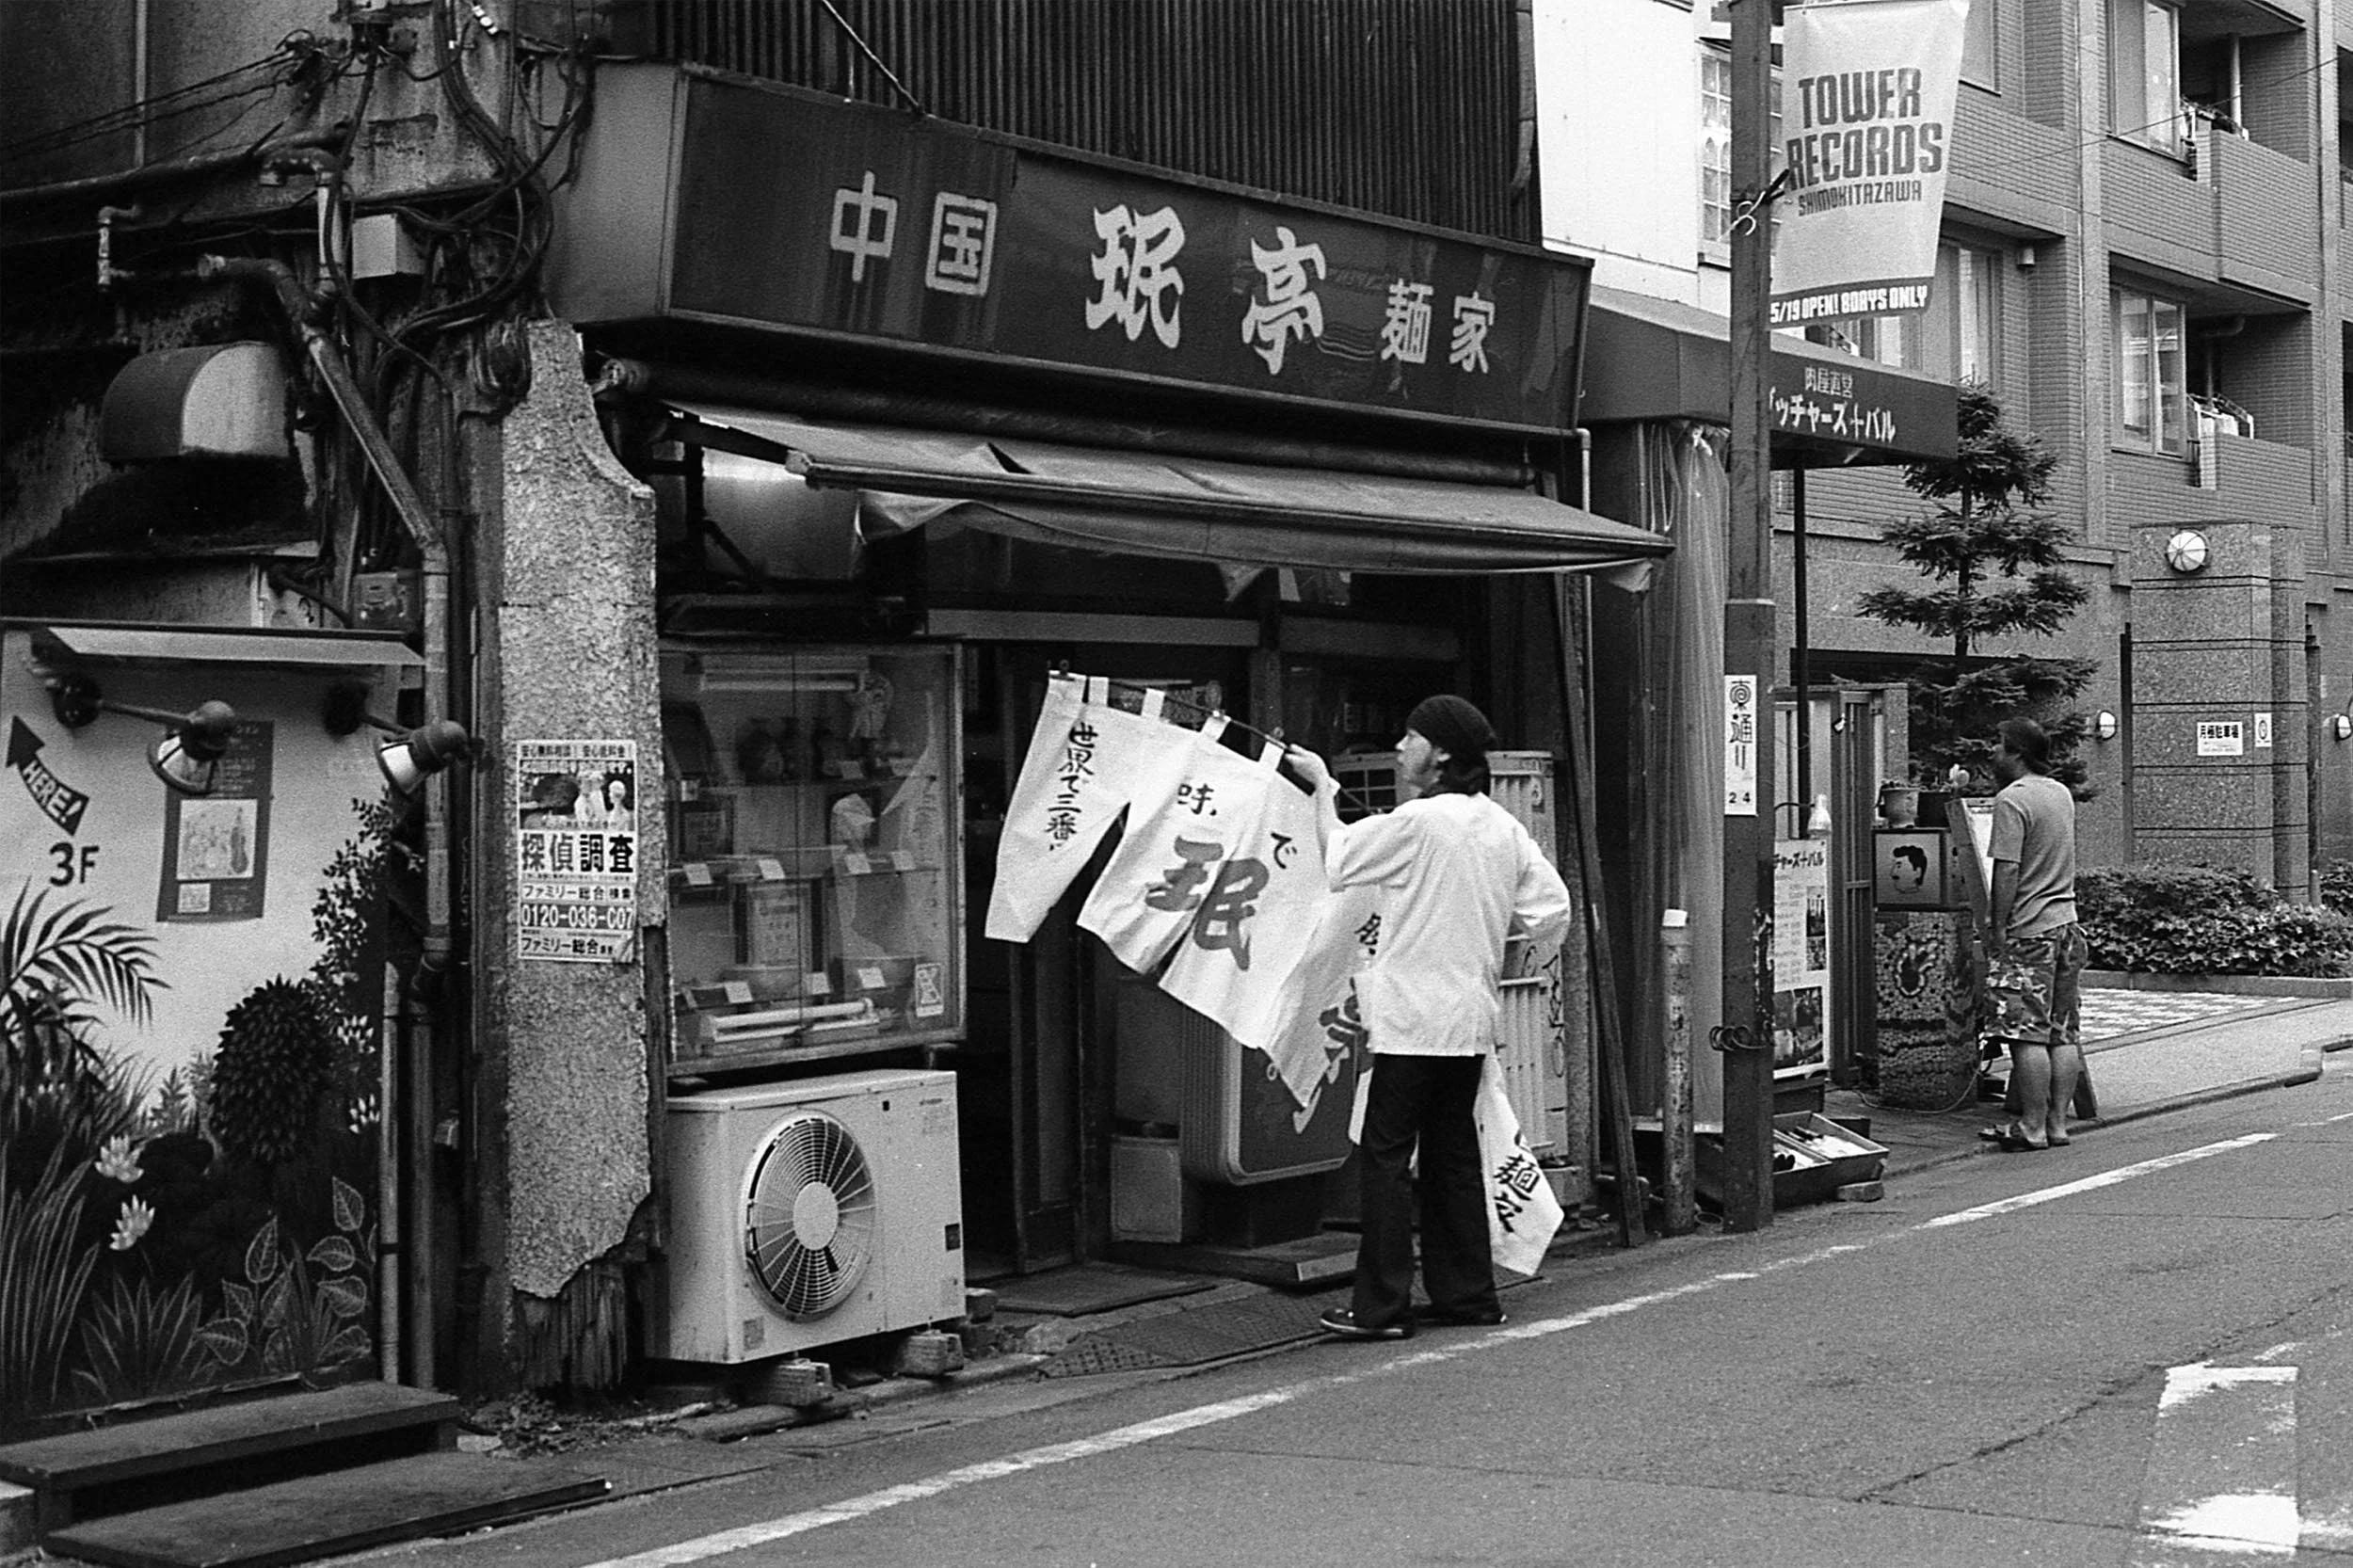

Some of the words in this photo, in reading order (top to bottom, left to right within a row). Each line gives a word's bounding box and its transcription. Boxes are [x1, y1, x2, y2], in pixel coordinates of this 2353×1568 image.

[1798, 68, 1921, 129] TOWER
[1786, 122, 1942, 191] RECORDS
[1798, 180, 1922, 216] SHIMOKITAZAWA
[829, 170, 999, 296] 中国
[1085, 203, 1327, 376] 珉亭
[1770, 299, 1801, 323] 5/19
[1801, 293, 1839, 320] OPEN!
[1889, 285, 1928, 310] ONLY
[23, 760, 82, 823] HERE!
[50, 842, 99, 887] 3F
[521, 833, 633, 872] 探偵調査
